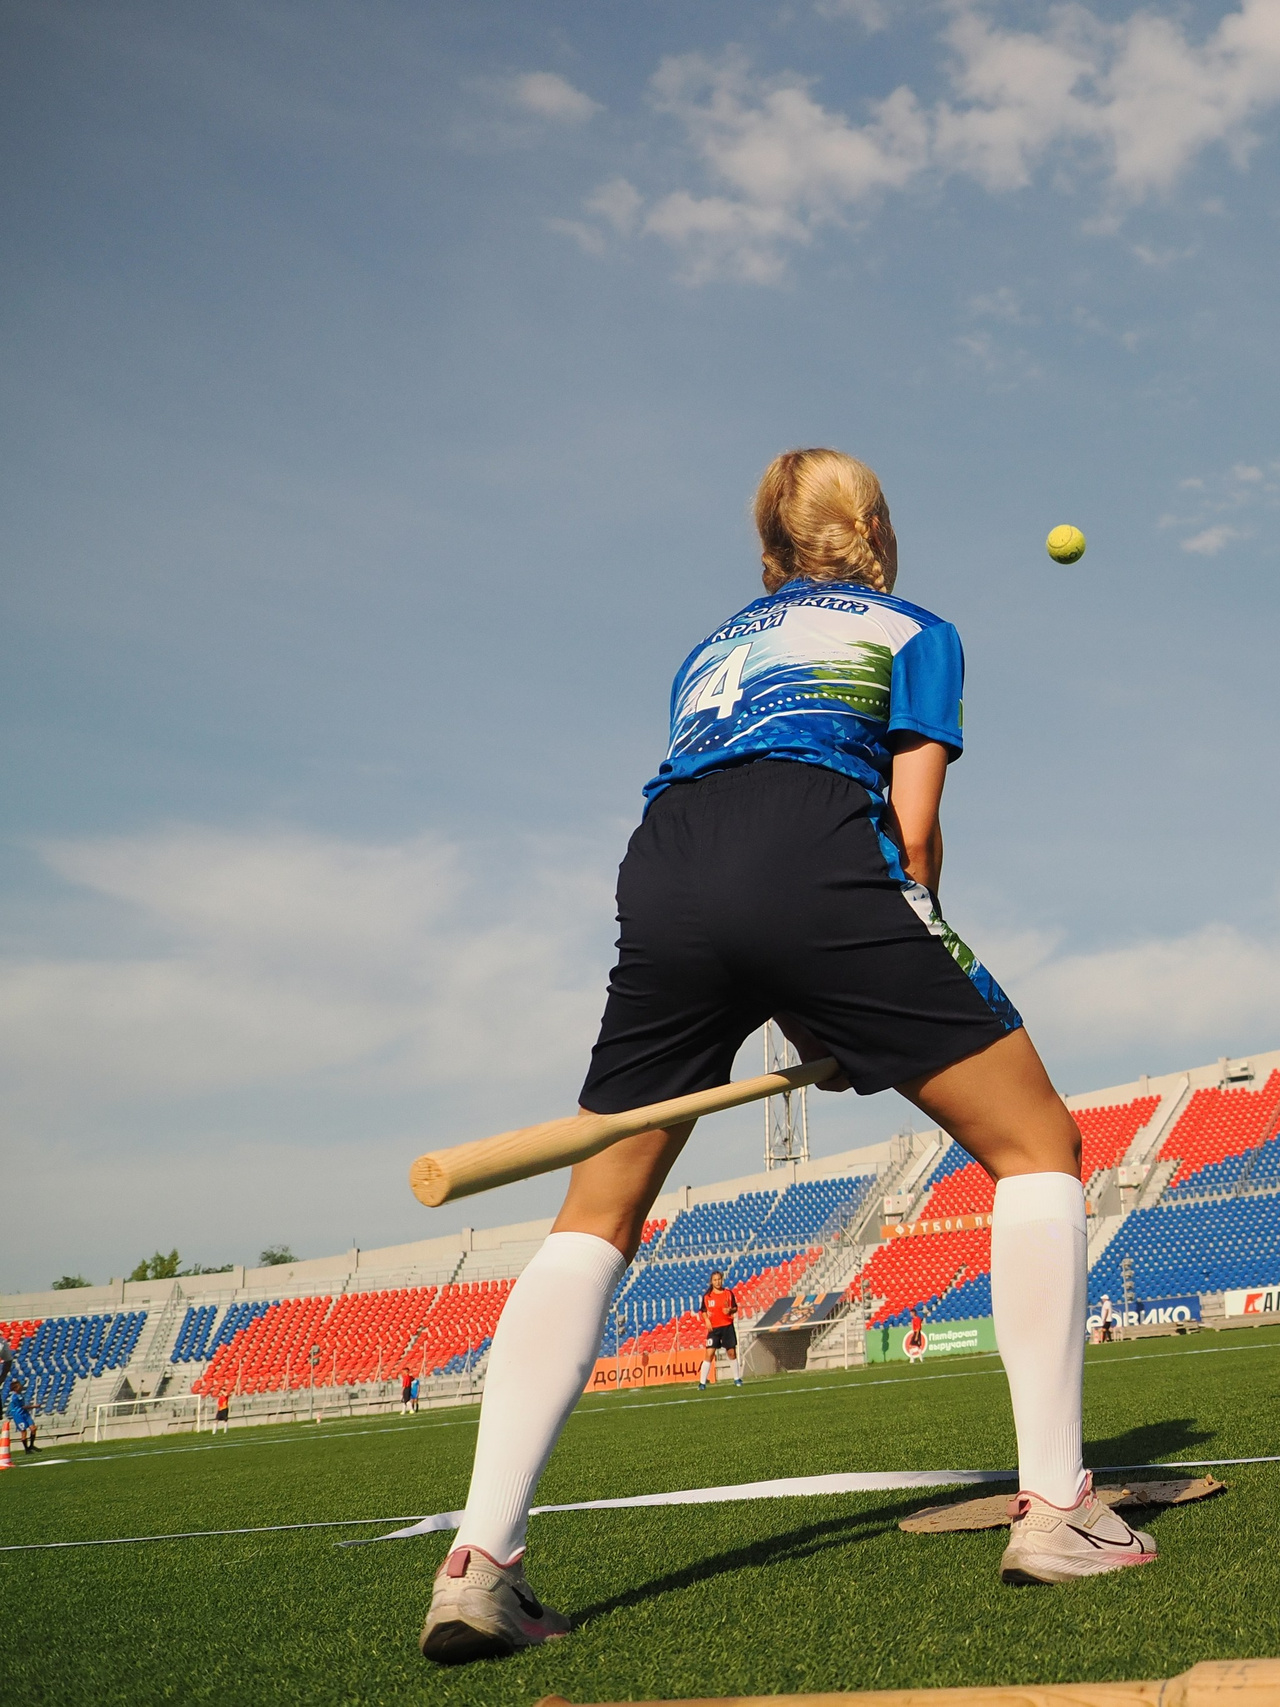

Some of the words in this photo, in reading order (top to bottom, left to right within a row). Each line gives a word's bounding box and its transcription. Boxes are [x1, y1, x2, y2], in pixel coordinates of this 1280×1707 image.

[711, 610, 784, 643] КРАЙ
[696, 642, 753, 719] 4
[895, 1219, 963, 1235] ФУТБОЛ
[708, 1299, 716, 1308] 10
[928, 1329, 978, 1342] Пятёрочка
[928, 1338, 978, 1352] выручает!
